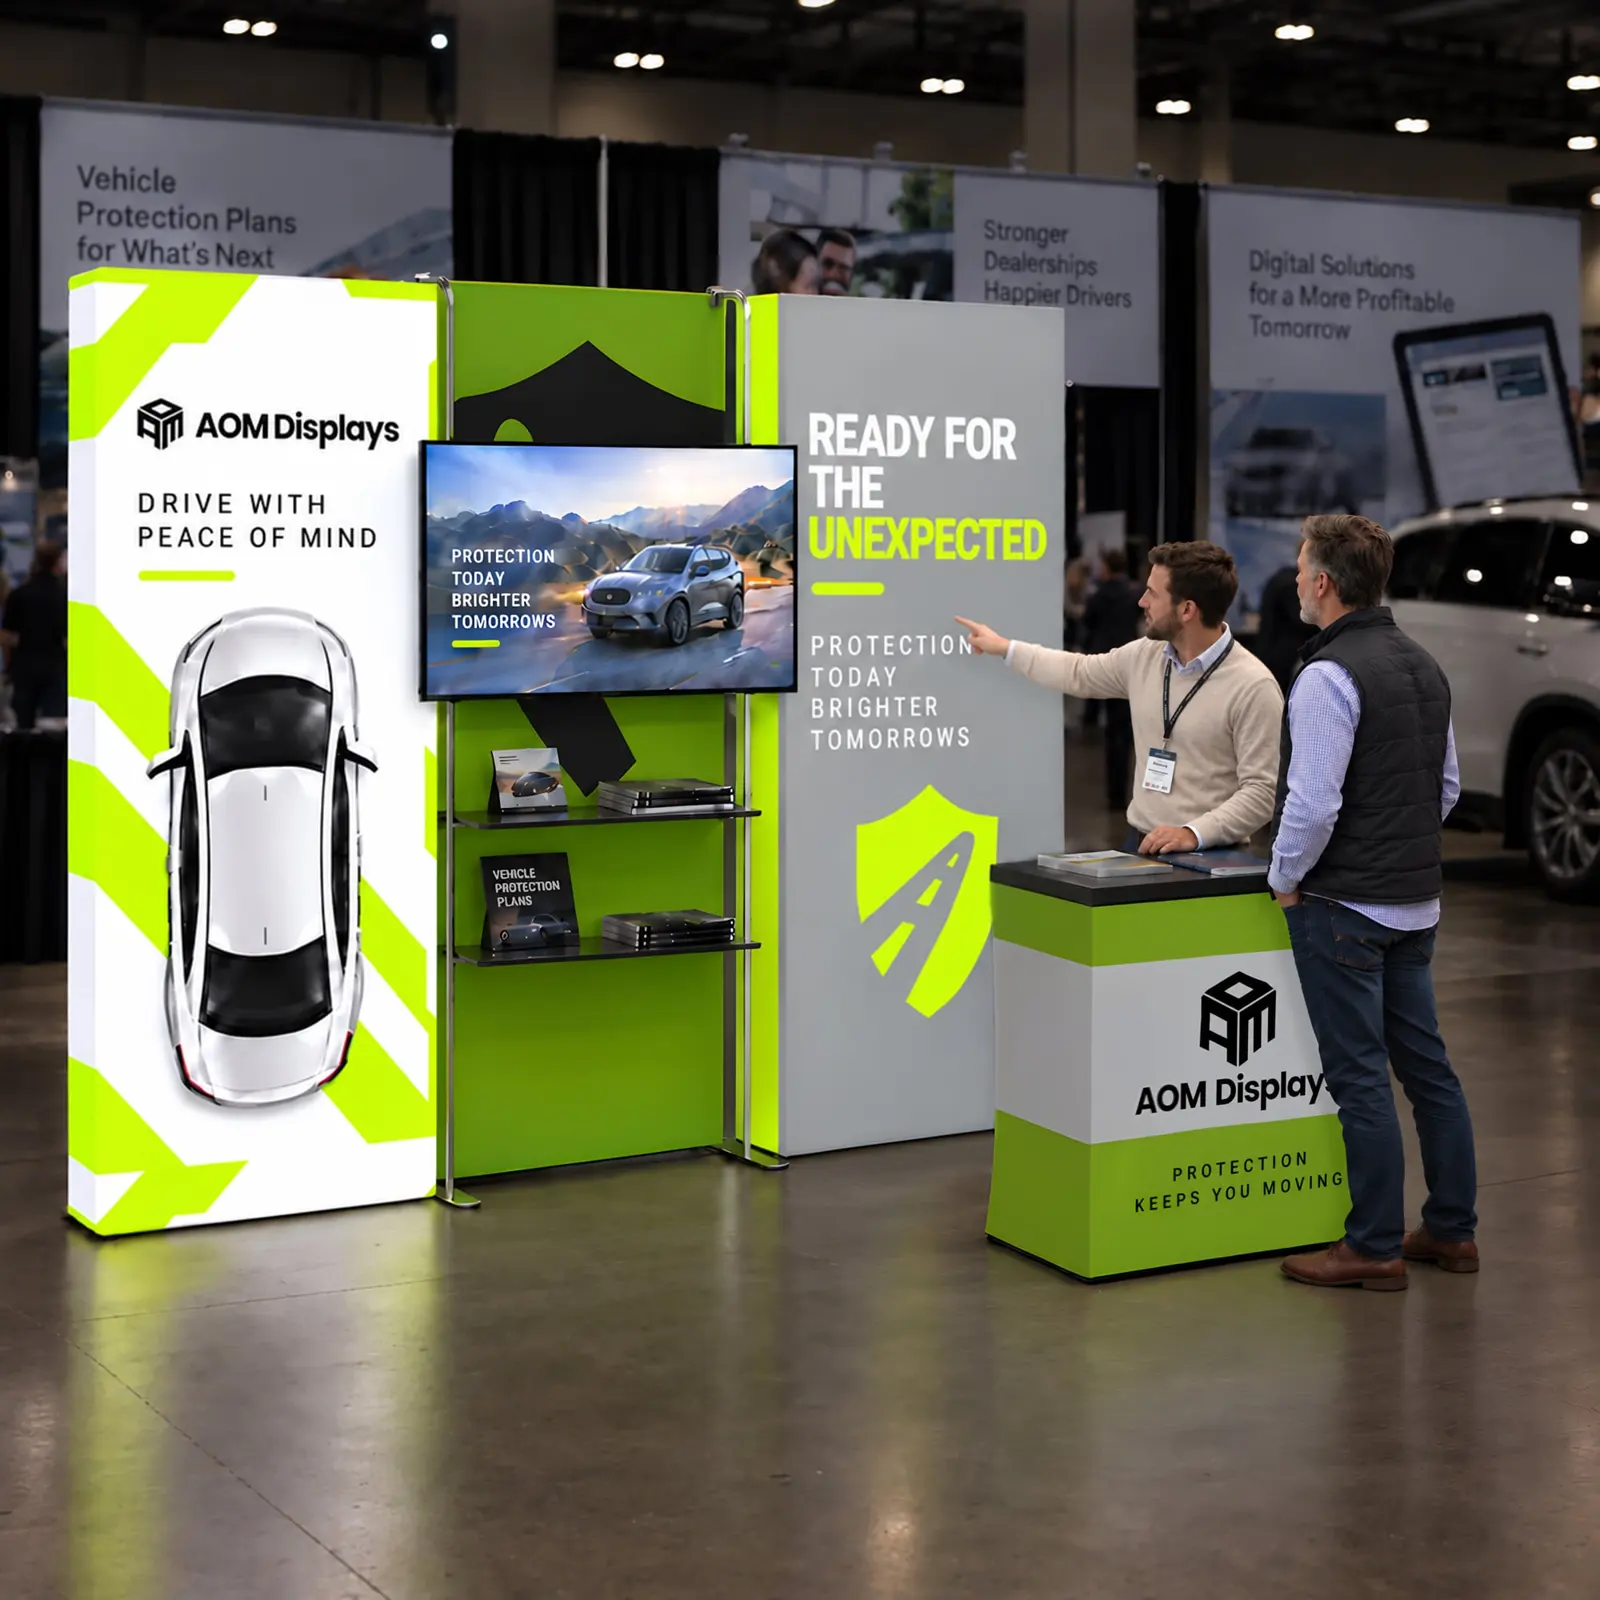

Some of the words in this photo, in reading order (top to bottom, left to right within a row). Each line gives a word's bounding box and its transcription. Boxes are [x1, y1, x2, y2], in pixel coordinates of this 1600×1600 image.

[77, 165, 176, 194] Vehicle
[77, 201, 218, 232] Protection
[226, 207, 297, 235] Plans
[984, 219, 1069, 247] Stronger
[77, 236, 115, 262] for
[122, 238, 209, 266] What's
[216, 243, 275, 269] Next
[984, 250, 1098, 278] Dealerships
[1249, 250, 1315, 280] Digital
[1321, 255, 1415, 280] Solutions
[984, 280, 1061, 305] Happier
[1066, 284, 1132, 308] Drivers
[1249, 282, 1279, 307] for
[1283, 290, 1294, 307] a
[1300, 285, 1351, 310] More
[1357, 288, 1455, 315] Profitable
[1249, 314, 1351, 341] Tomorrow
[196, 412, 269, 439] AOM
[274, 411, 400, 450] Displays
[809, 413, 935, 458] READY
[945, 416, 1017, 461] FOR
[808, 465, 884, 509] THE
[139, 493, 232, 514] DRIVE
[250, 494, 325, 515] WITH
[139, 526, 233, 548] PEACE
[250, 527, 285, 548] OF
[301, 527, 377, 548] MIND
[808, 516, 1048, 561] UNEXPECTED
[452, 549, 555, 563] PROTECTION
[452, 571, 505, 586] TODAY
[452, 593, 531, 607] BRIGHTER
[452, 614, 556, 629] TOMORROWS
[811, 634, 972, 656] PROTECTION
[811, 667, 897, 687] TODAY
[811, 696, 938, 719] BRIGHTER
[811, 726, 971, 750] TOMORROWS
[493, 868, 536, 880] VEHICLE
[495, 880, 560, 894] PROTECTION
[497, 896, 533, 908] PLANS
[1135, 1080, 1206, 1116] AOM
[1215, 1071, 1331, 1111] Display
[1172, 1151, 1308, 1182] PROTECTION
[1134, 1188, 1201, 1213] KEEPS
[1212, 1183, 1251, 1203] YOU
[1263, 1171, 1343, 1197] MOVING
